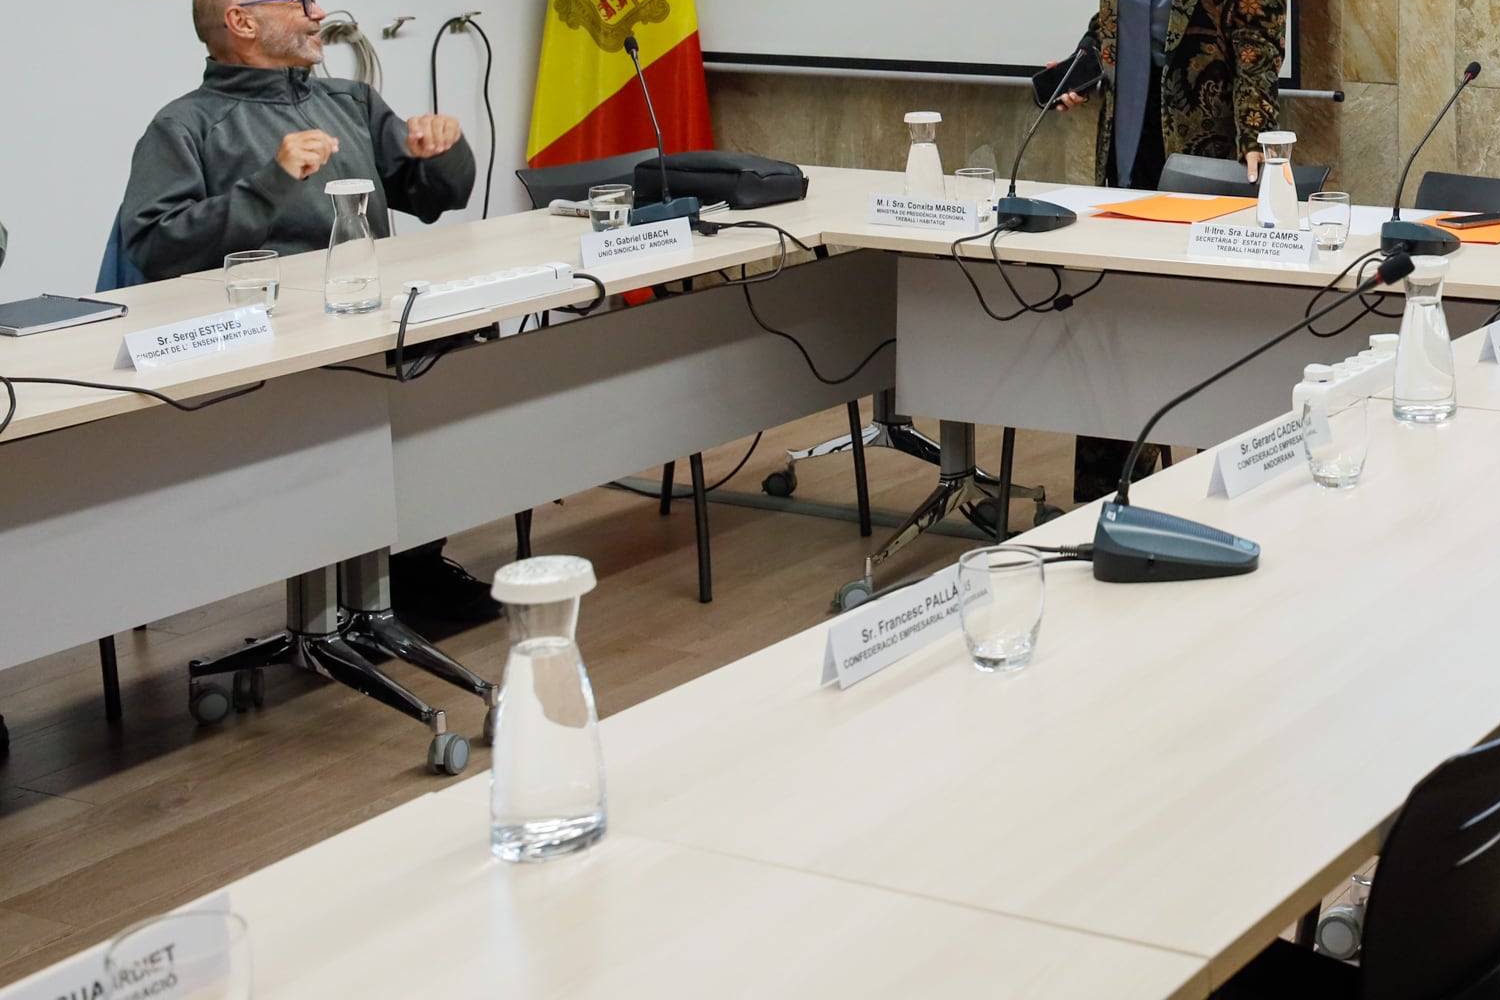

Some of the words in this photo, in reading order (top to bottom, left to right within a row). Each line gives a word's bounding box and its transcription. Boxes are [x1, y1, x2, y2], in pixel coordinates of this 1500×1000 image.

[892, 200, 905, 208] Sra.
[907, 202, 933, 211] Conxita
[935, 204, 966, 214] MARSOL
[919, 218, 945, 226] HABITATGE
[604, 240, 614, 248] Sr.
[616, 234, 641, 246] Gabriel
[642, 229, 669, 241] UBACH
[1195, 235, 1232, 244] SECRETÀRIA
[1228, 228, 1242, 236] Sra.
[1245, 230, 1267, 239] Laura
[1269, 232, 1299, 241] CAMPS
[614, 245, 639, 255] SINDICAL
[649, 238, 677, 248] ANDORRA
[1217, 245, 1243, 253] TREBALL
[1247, 247, 1280, 256] HABITATGE
[157, 336, 172, 346] Sr.
[173, 329, 198, 343] Sergi
[199, 320, 242, 336] ESTEVES
[171, 345, 181, 354] DE
[1252, 431, 1276, 450] Gerard
[1237, 445, 1278, 470] CONFEDERACIÓ
[1263, 450, 1295, 471] ANDORRANA
[861, 628, 877, 644] Sr.
[878, 605, 924, 636] Francesc
[843, 633, 898, 670] CONFEDERACIÓ
[899, 612, 944, 641] EMPRESARIAL
